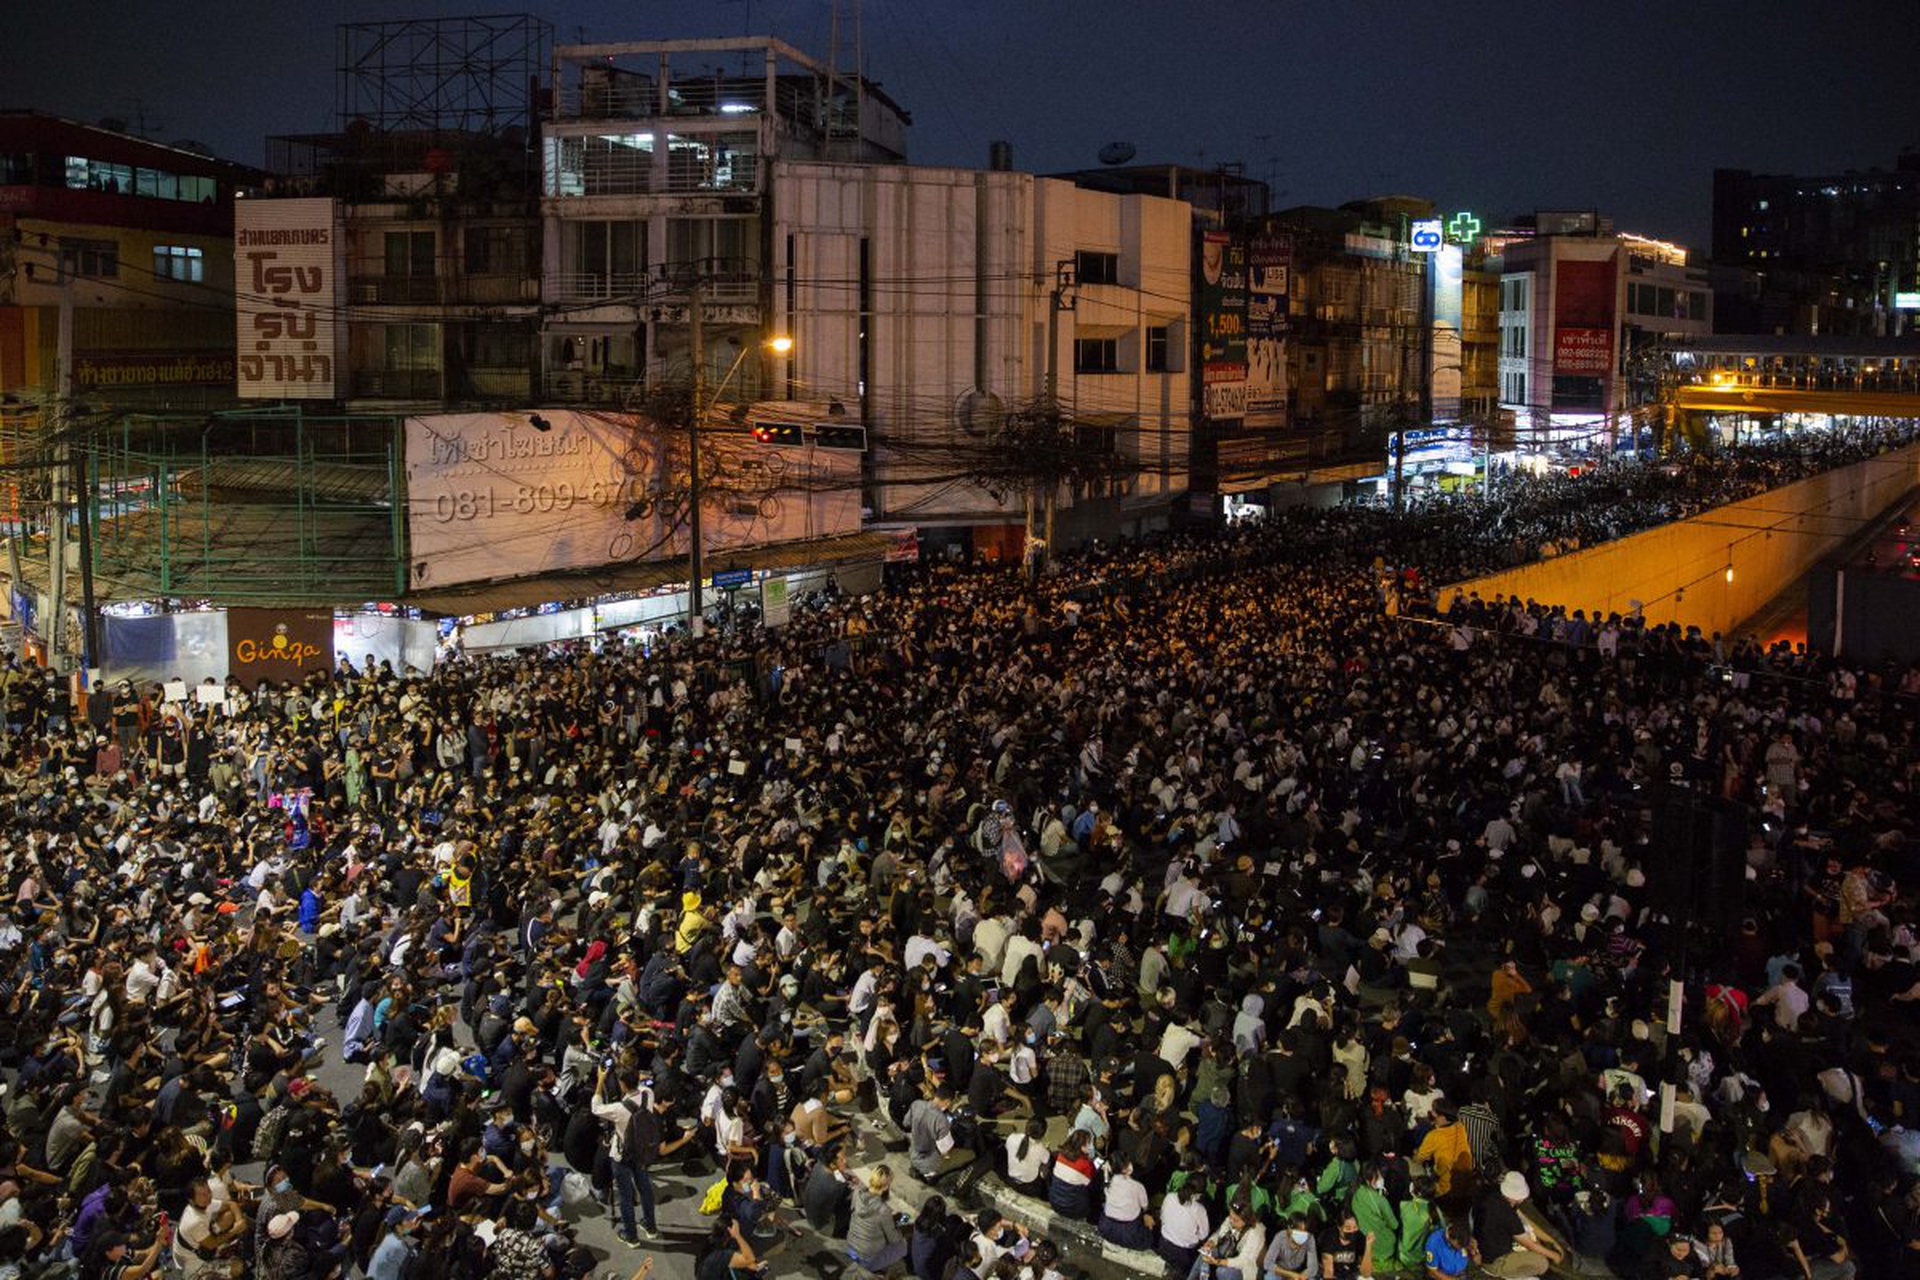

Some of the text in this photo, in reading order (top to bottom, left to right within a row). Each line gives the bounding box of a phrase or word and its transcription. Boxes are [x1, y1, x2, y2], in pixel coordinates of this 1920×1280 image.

[247, 251, 323, 294] โรง
[253, 296, 316, 339] รับ
[240, 341, 331, 383] จำนำ
[424, 423, 594, 466] ให้เช่าโฆษณา
[236, 639, 321, 667] Ginza
